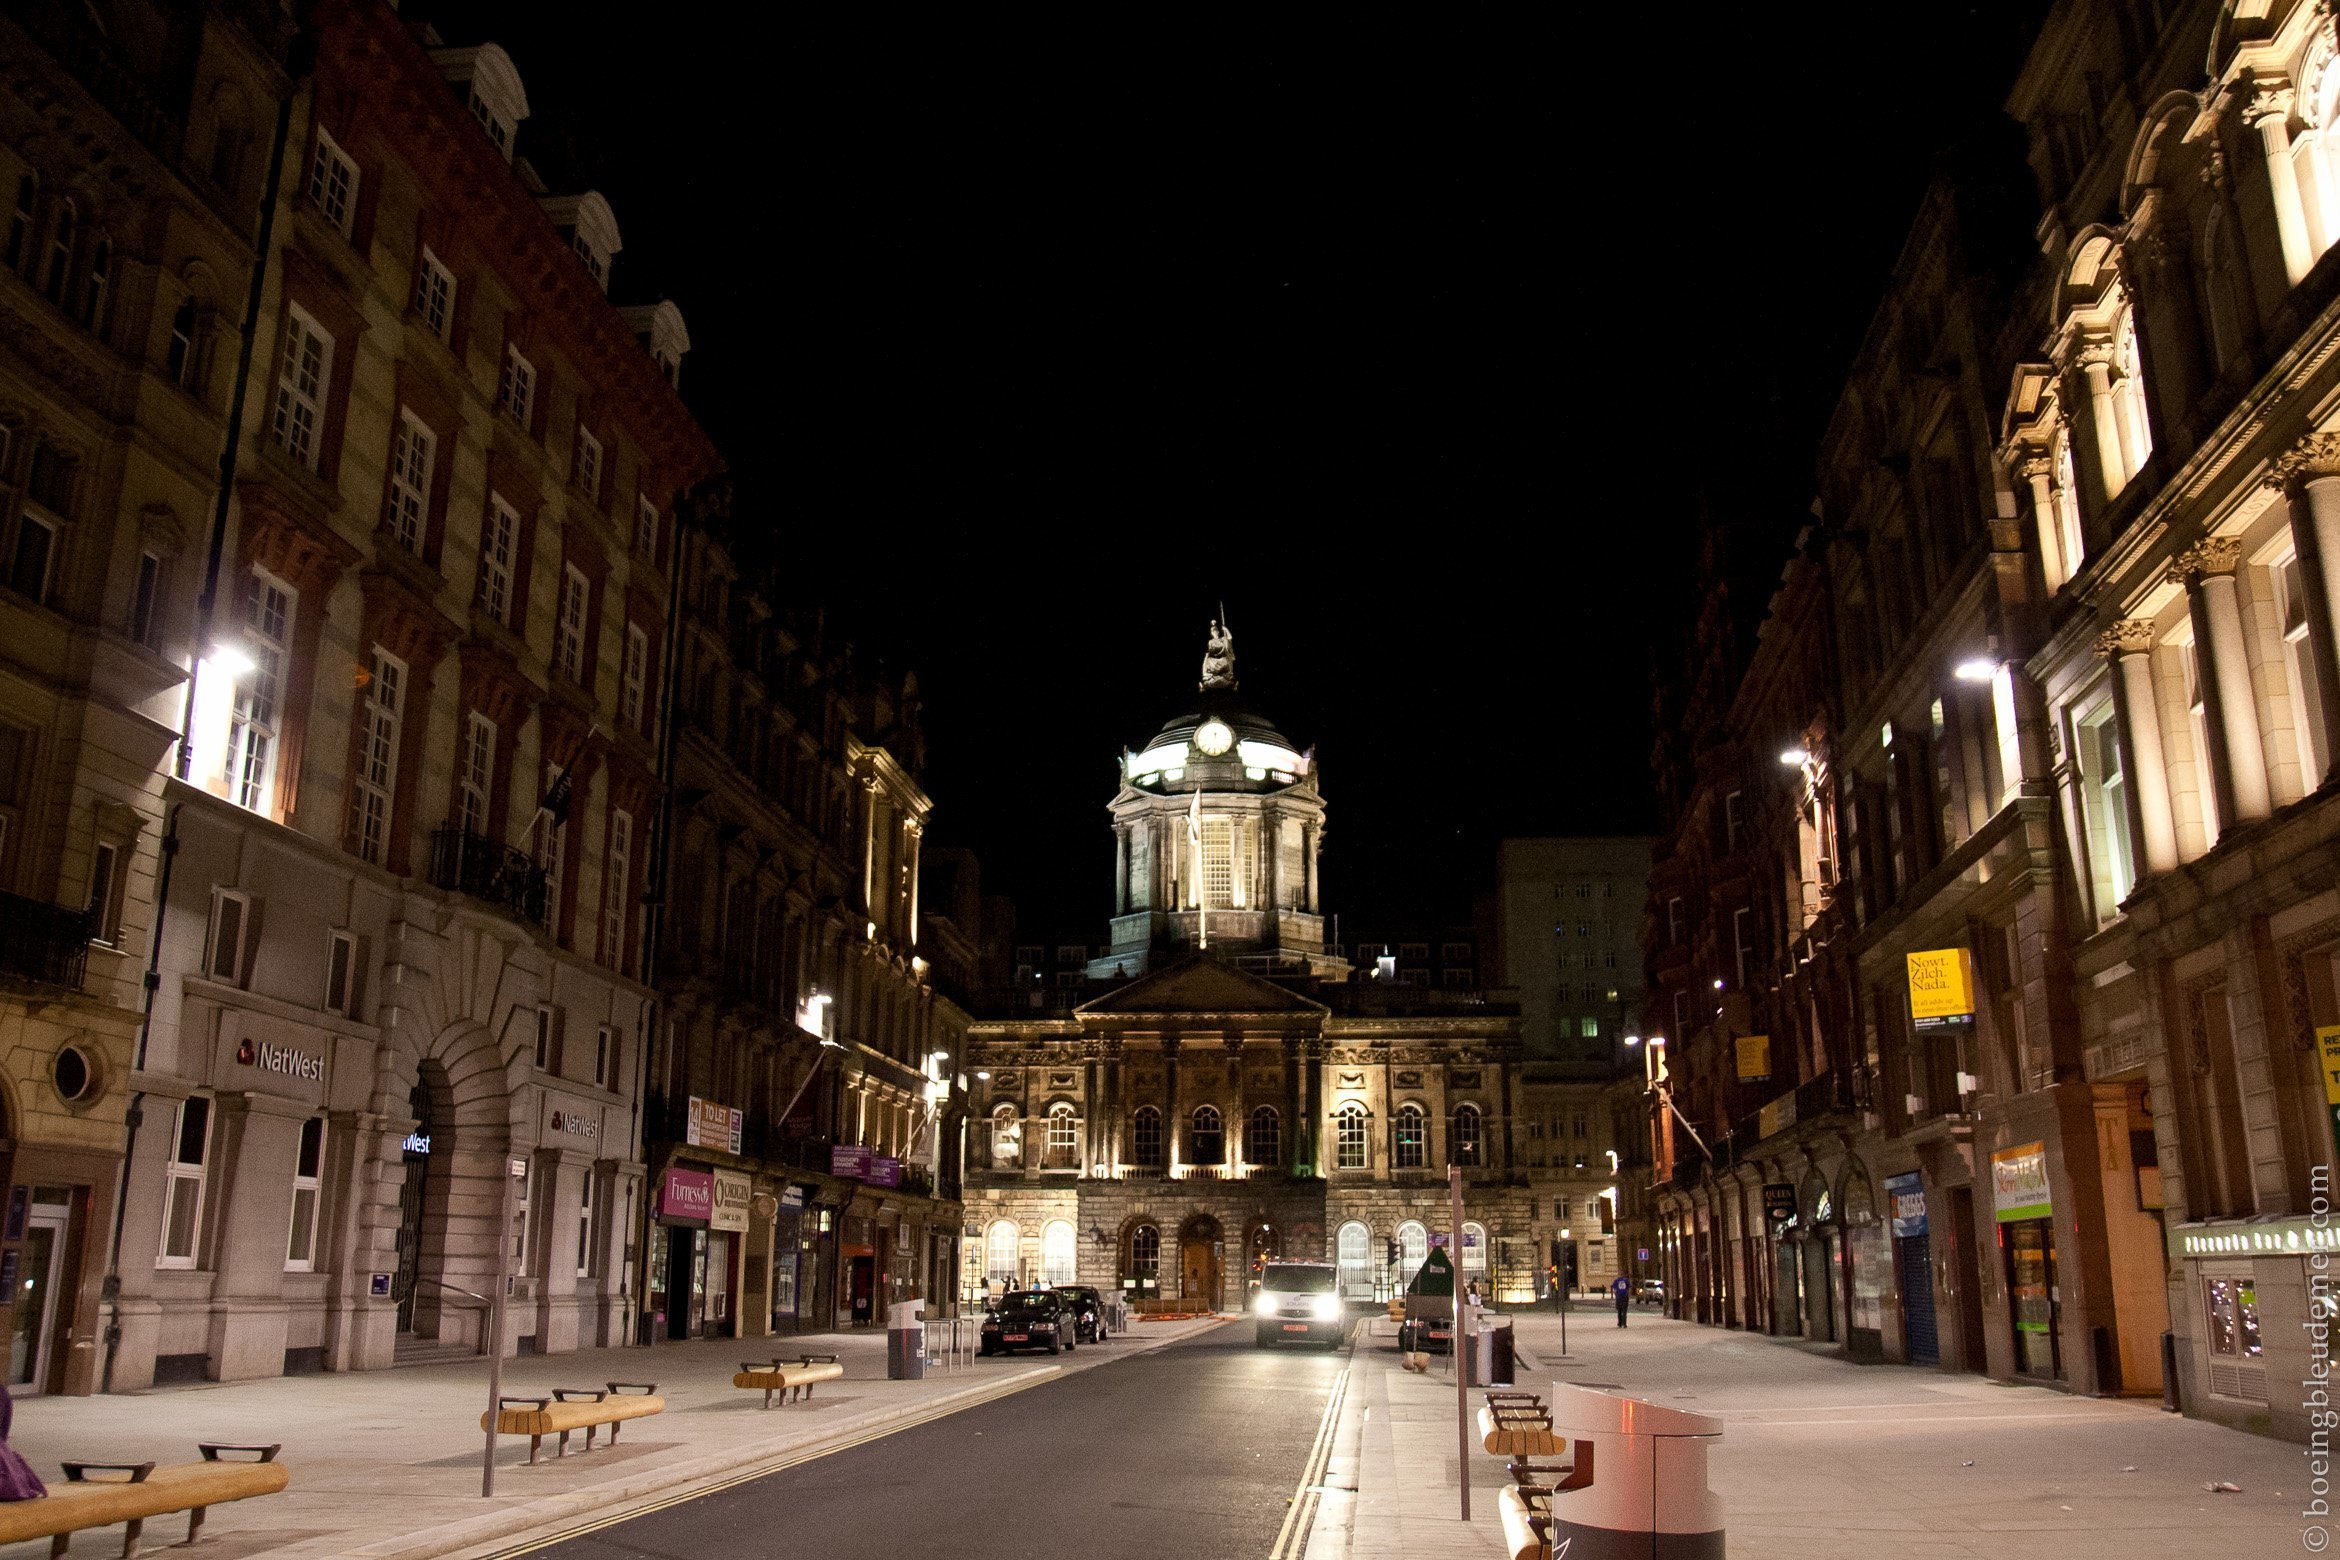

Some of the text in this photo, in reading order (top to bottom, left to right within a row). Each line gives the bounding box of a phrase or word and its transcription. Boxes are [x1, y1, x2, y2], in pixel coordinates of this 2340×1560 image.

[1911, 957, 1948, 971] Nowt.
[1912, 967, 1947, 980] Zilch.
[1912, 978, 1950, 991] Nada.
[259, 1042, 324, 1081] NatWest
[705, 1104, 714, 1120] TO
[715, 1107, 727, 1124] LET
[563, 1113, 598, 1138] NatWest
[402, 1133, 430, 1153] West
[725, 1182, 749, 1201] ORIGIN
